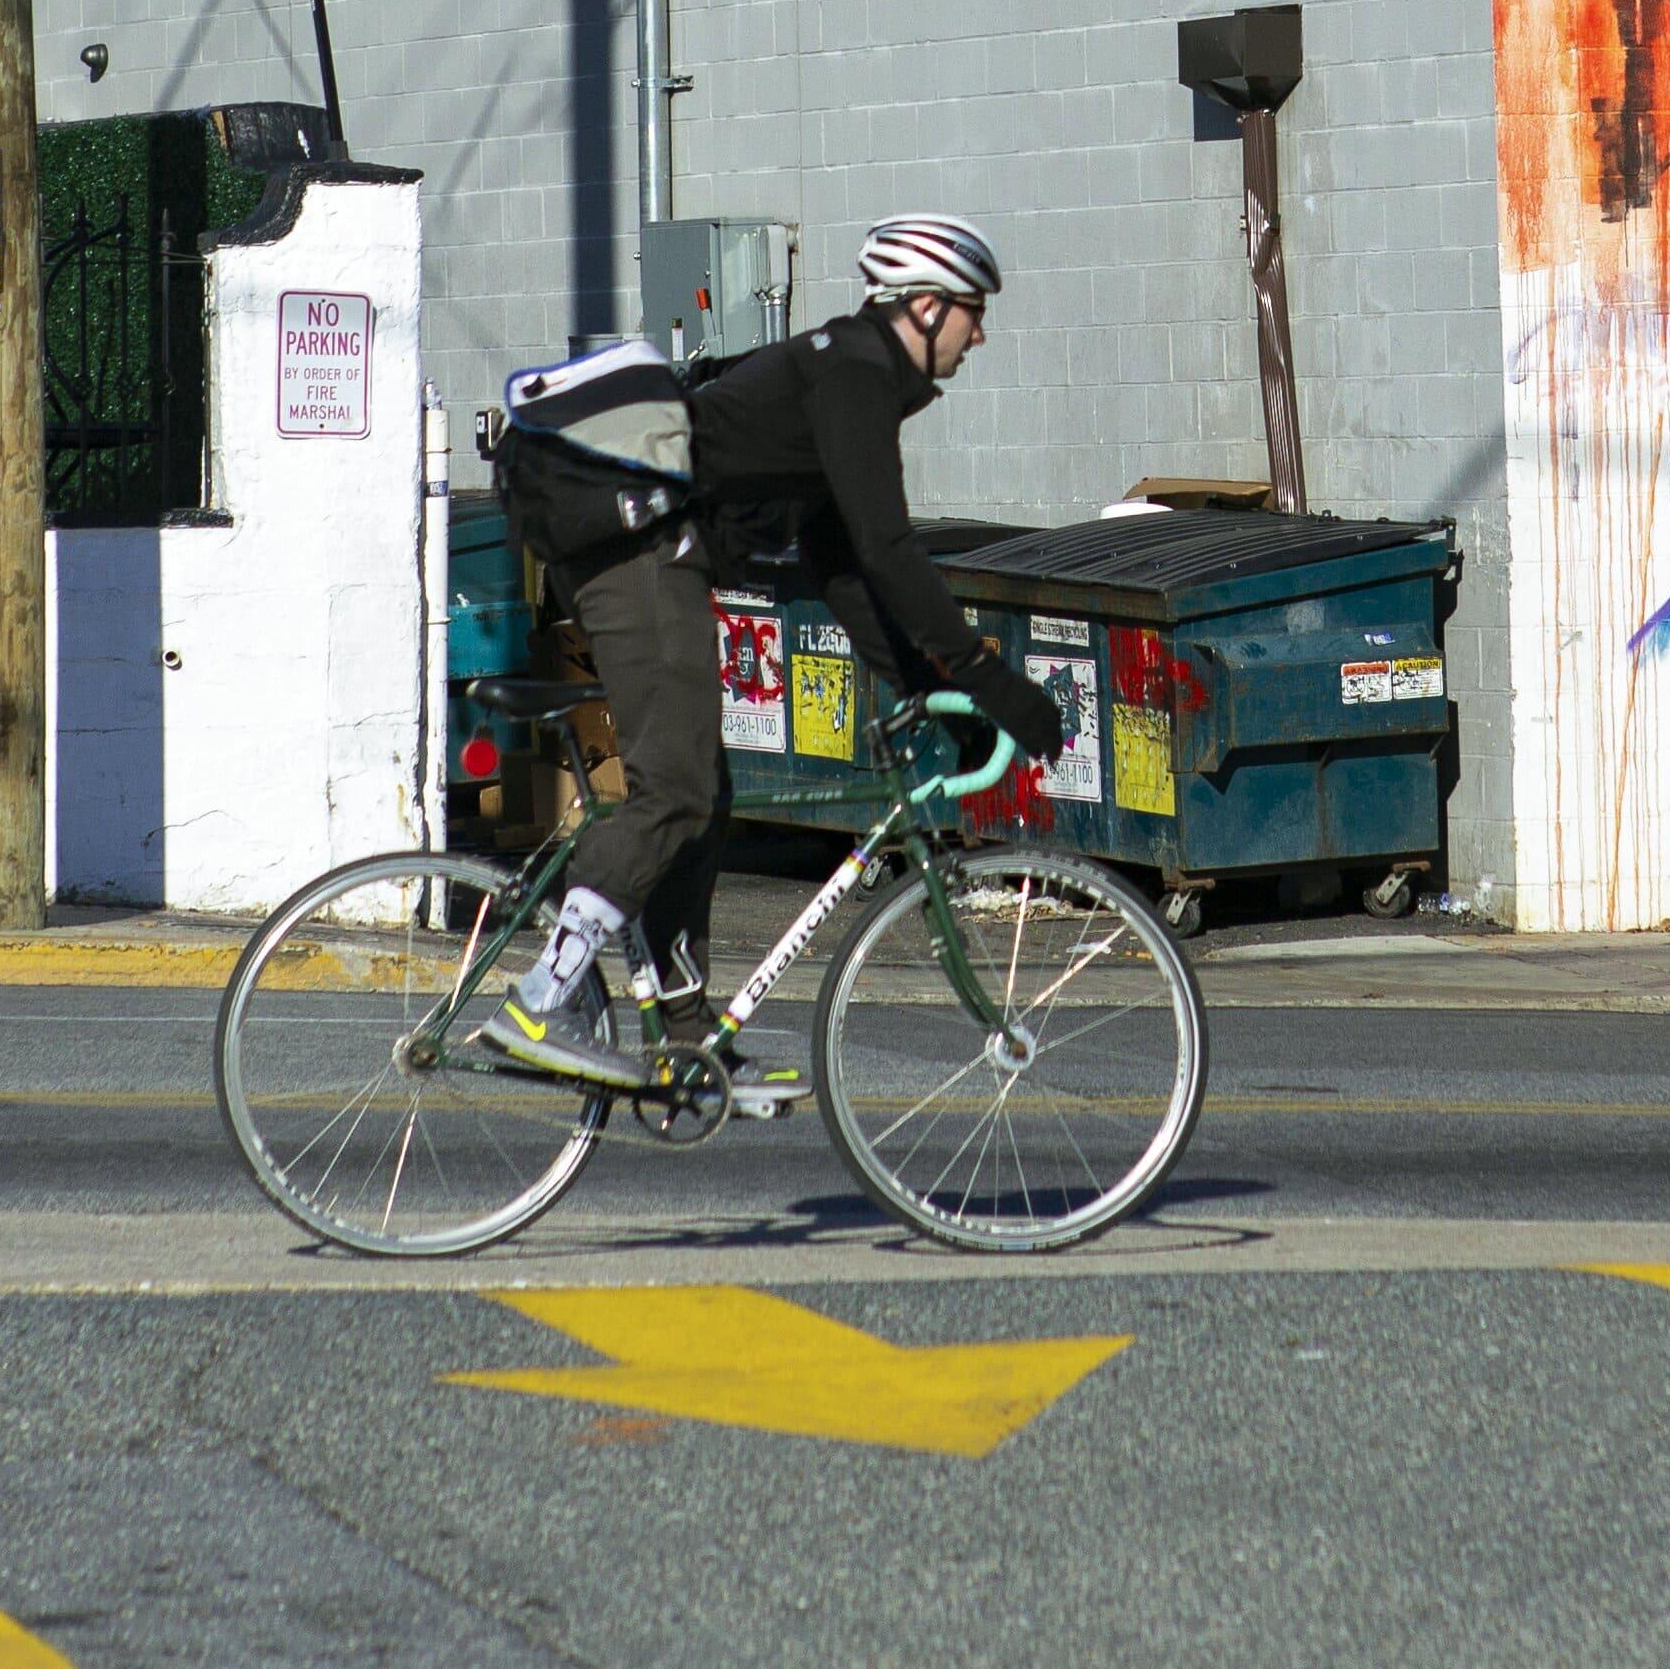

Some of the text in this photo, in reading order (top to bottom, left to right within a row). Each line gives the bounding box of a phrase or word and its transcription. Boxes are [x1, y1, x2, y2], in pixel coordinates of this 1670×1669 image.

[308, 302, 340, 327] NO
[286, 331, 361, 357] PARKING
[284, 367, 361, 381] BY ORDER OF
[307, 385, 338, 401] FIRE
[723, 713, 777, 737] 03-961-1100
[747, 876, 845, 1004] Bianchi
